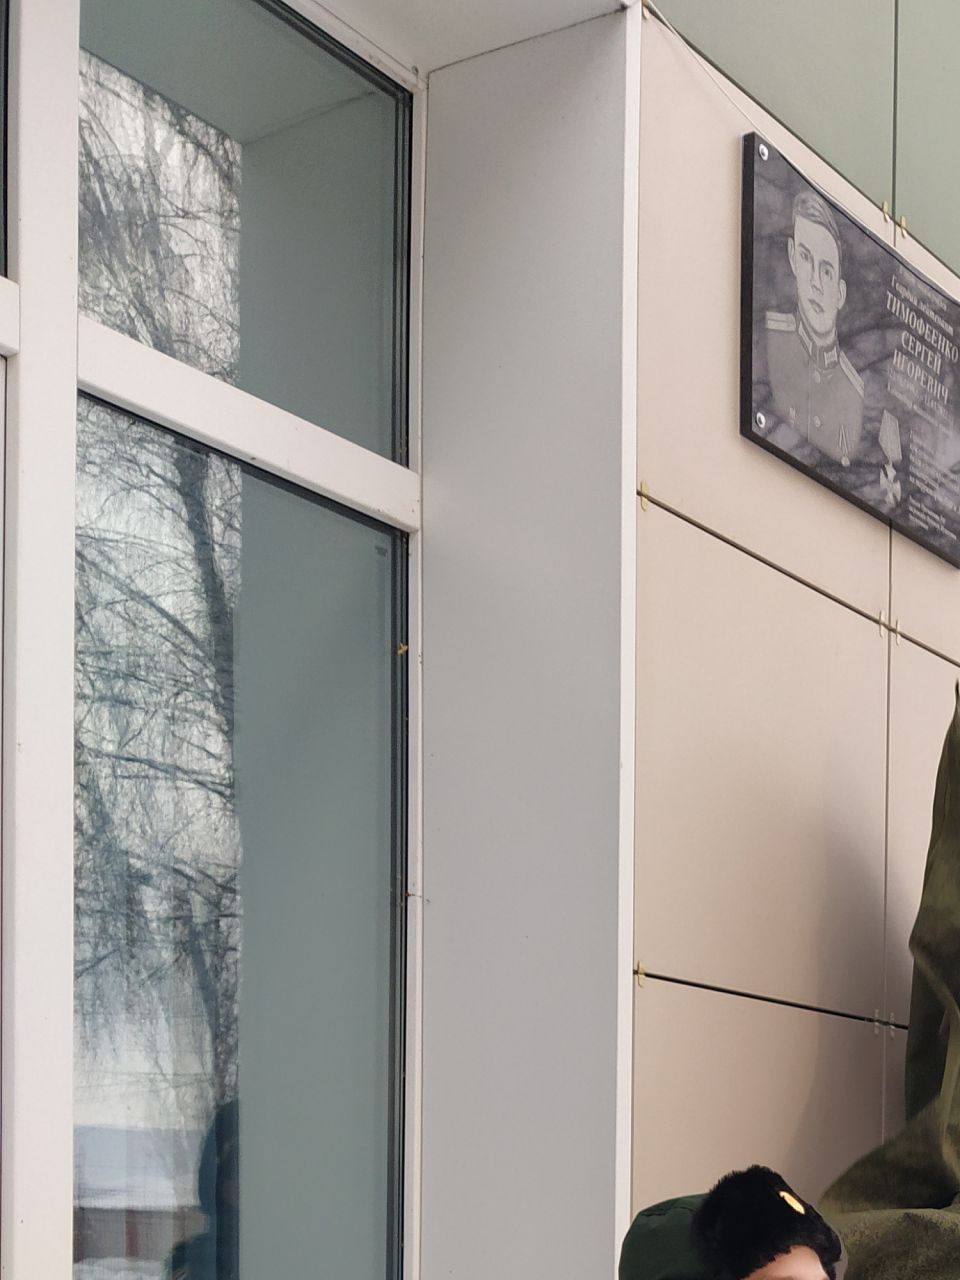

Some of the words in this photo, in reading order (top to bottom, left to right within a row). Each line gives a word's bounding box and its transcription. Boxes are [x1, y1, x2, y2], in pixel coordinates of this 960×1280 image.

[886, 290, 959, 363] ТИМОФЕЕНКО
[901, 331, 943, 375] СЕРГЕЙ
[893, 348, 949, 405] ИГОРЕВИЧ
